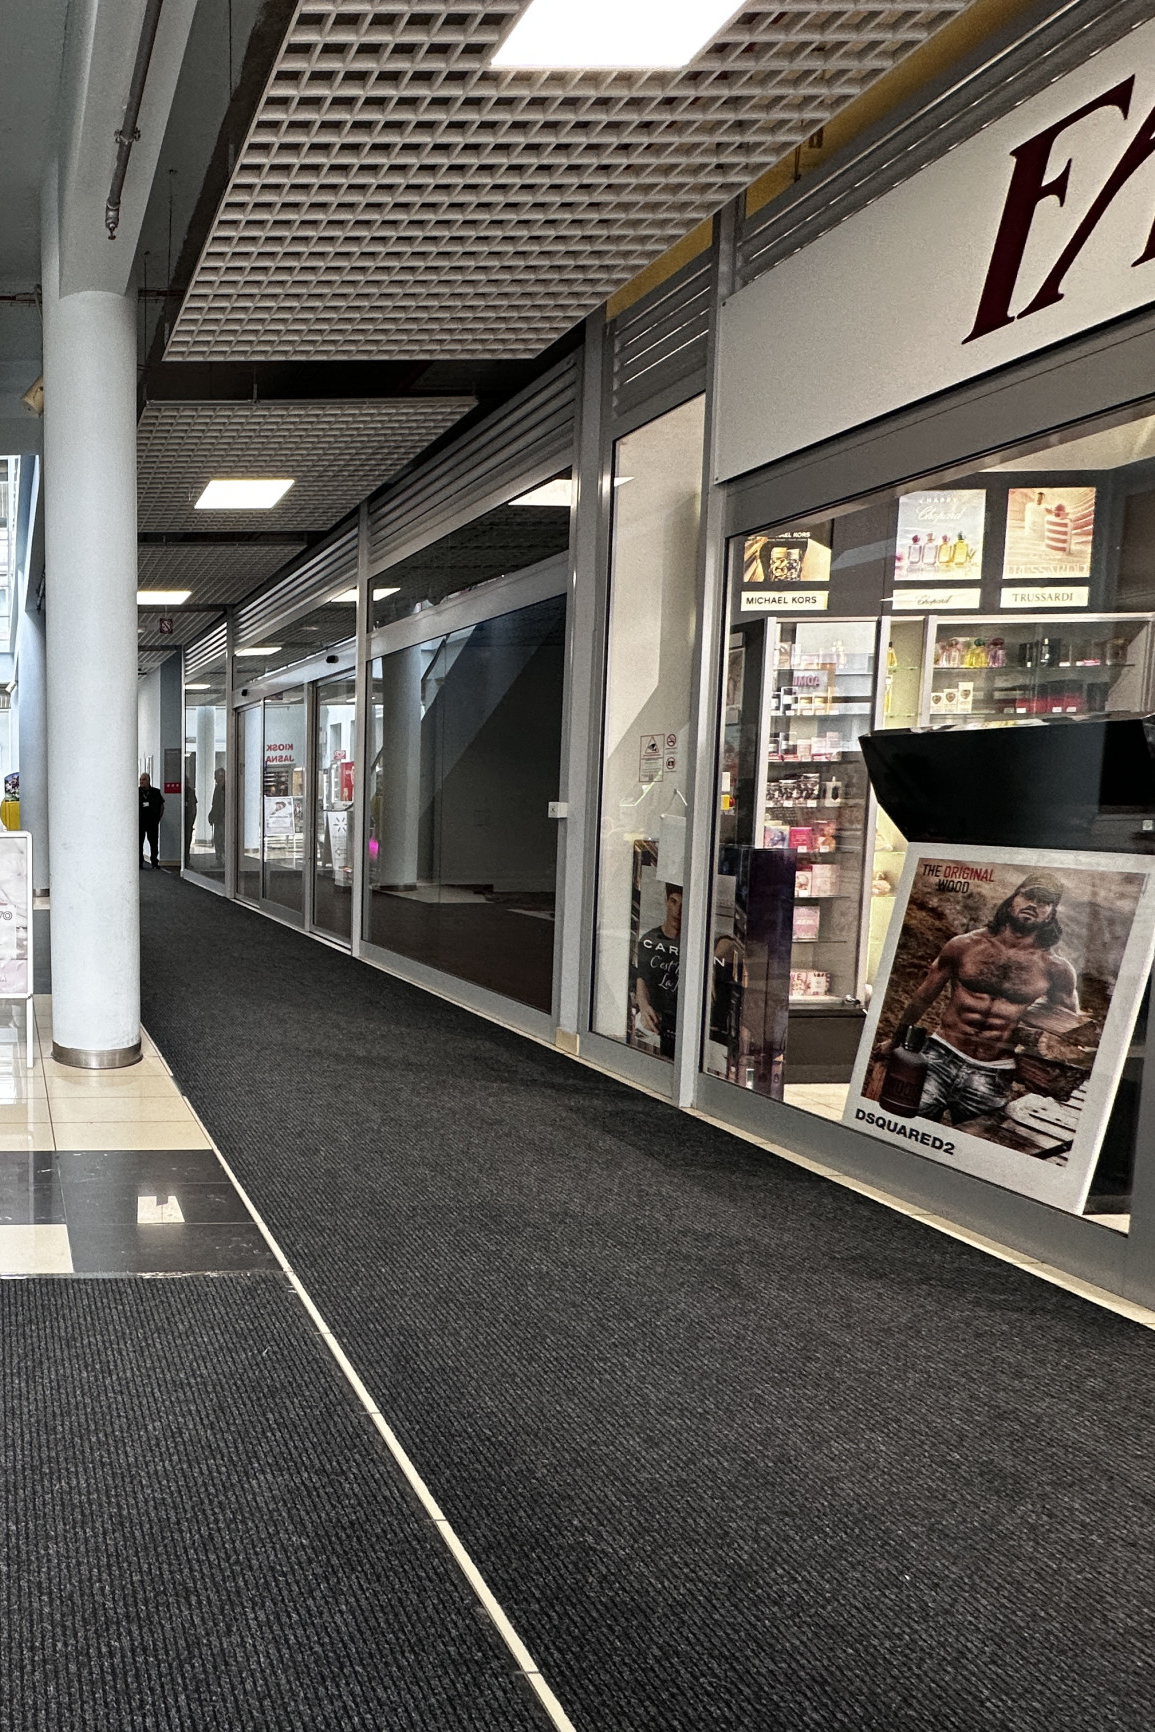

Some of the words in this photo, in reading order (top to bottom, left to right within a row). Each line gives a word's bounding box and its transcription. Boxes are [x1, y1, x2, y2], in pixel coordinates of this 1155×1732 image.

[916, 505, 967, 524] Chopard
[746, 597, 789, 605] MICHAEL
[791, 596, 817, 605] KORS
[1012, 592, 1074, 603] TRUSSARDI
[922, 863, 943, 878] THE
[943, 865, 995, 883] ORIGINAL
[935, 878, 970, 894] WOOD
[855, 1108, 956, 1156] DSQUARED2
